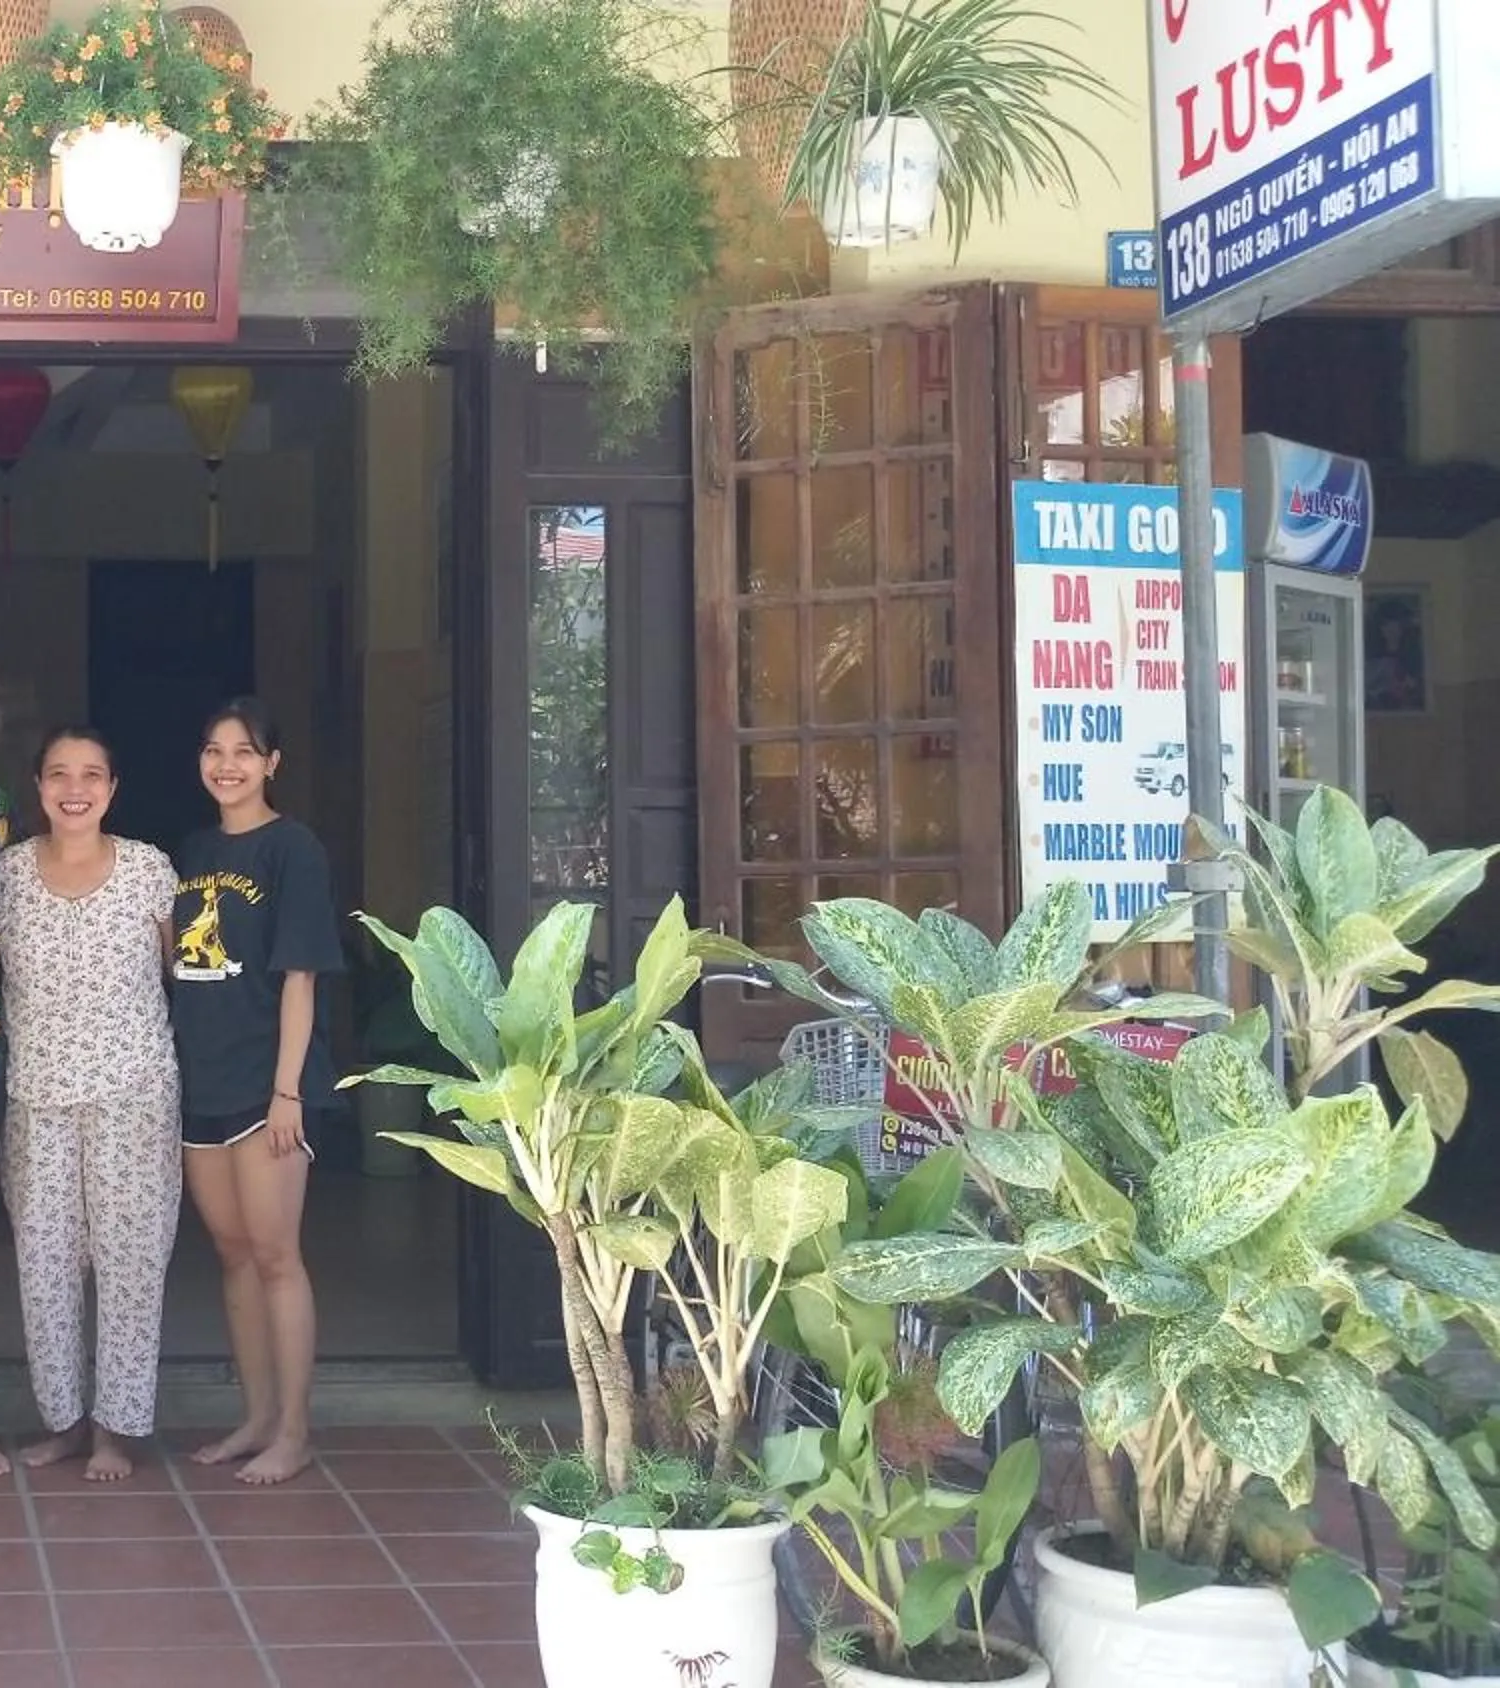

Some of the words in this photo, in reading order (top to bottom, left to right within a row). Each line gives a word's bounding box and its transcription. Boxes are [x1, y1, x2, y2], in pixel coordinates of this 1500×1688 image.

[1176, 0, 1393, 181] LUSTY
[1385, 102, 1417, 150] AN
[1215, 235, 1253, 278] 01638
[1283, 207, 1308, 246] 710
[1359, 167, 1386, 208] 120
[1117, 239, 1155, 271] 13
[1167, 212, 1210, 301] 138
[0, 289, 39, 307] Tel:
[49, 288, 114, 310] 01638
[119, 289, 161, 311] 504
[167, 290, 205, 310] 710
[1034, 502, 1114, 551] TAXI
[1128, 504, 1227, 555] GOD
[1053, 574, 1091, 623] DA
[1135, 579, 1183, 611] AIRPO
[1136, 620, 1169, 650] CITY
[1033, 640, 1113, 690] NANG
[1136, 660, 1177, 690] TRAIN
[1042, 704, 1073, 743] MY
[1081, 705, 1123, 743] SON
[1043, 764, 1083, 802] HUE
[1044, 824, 1126, 861] MARBLE
[1094, 1029, 1163, 1050] OMESTAY
